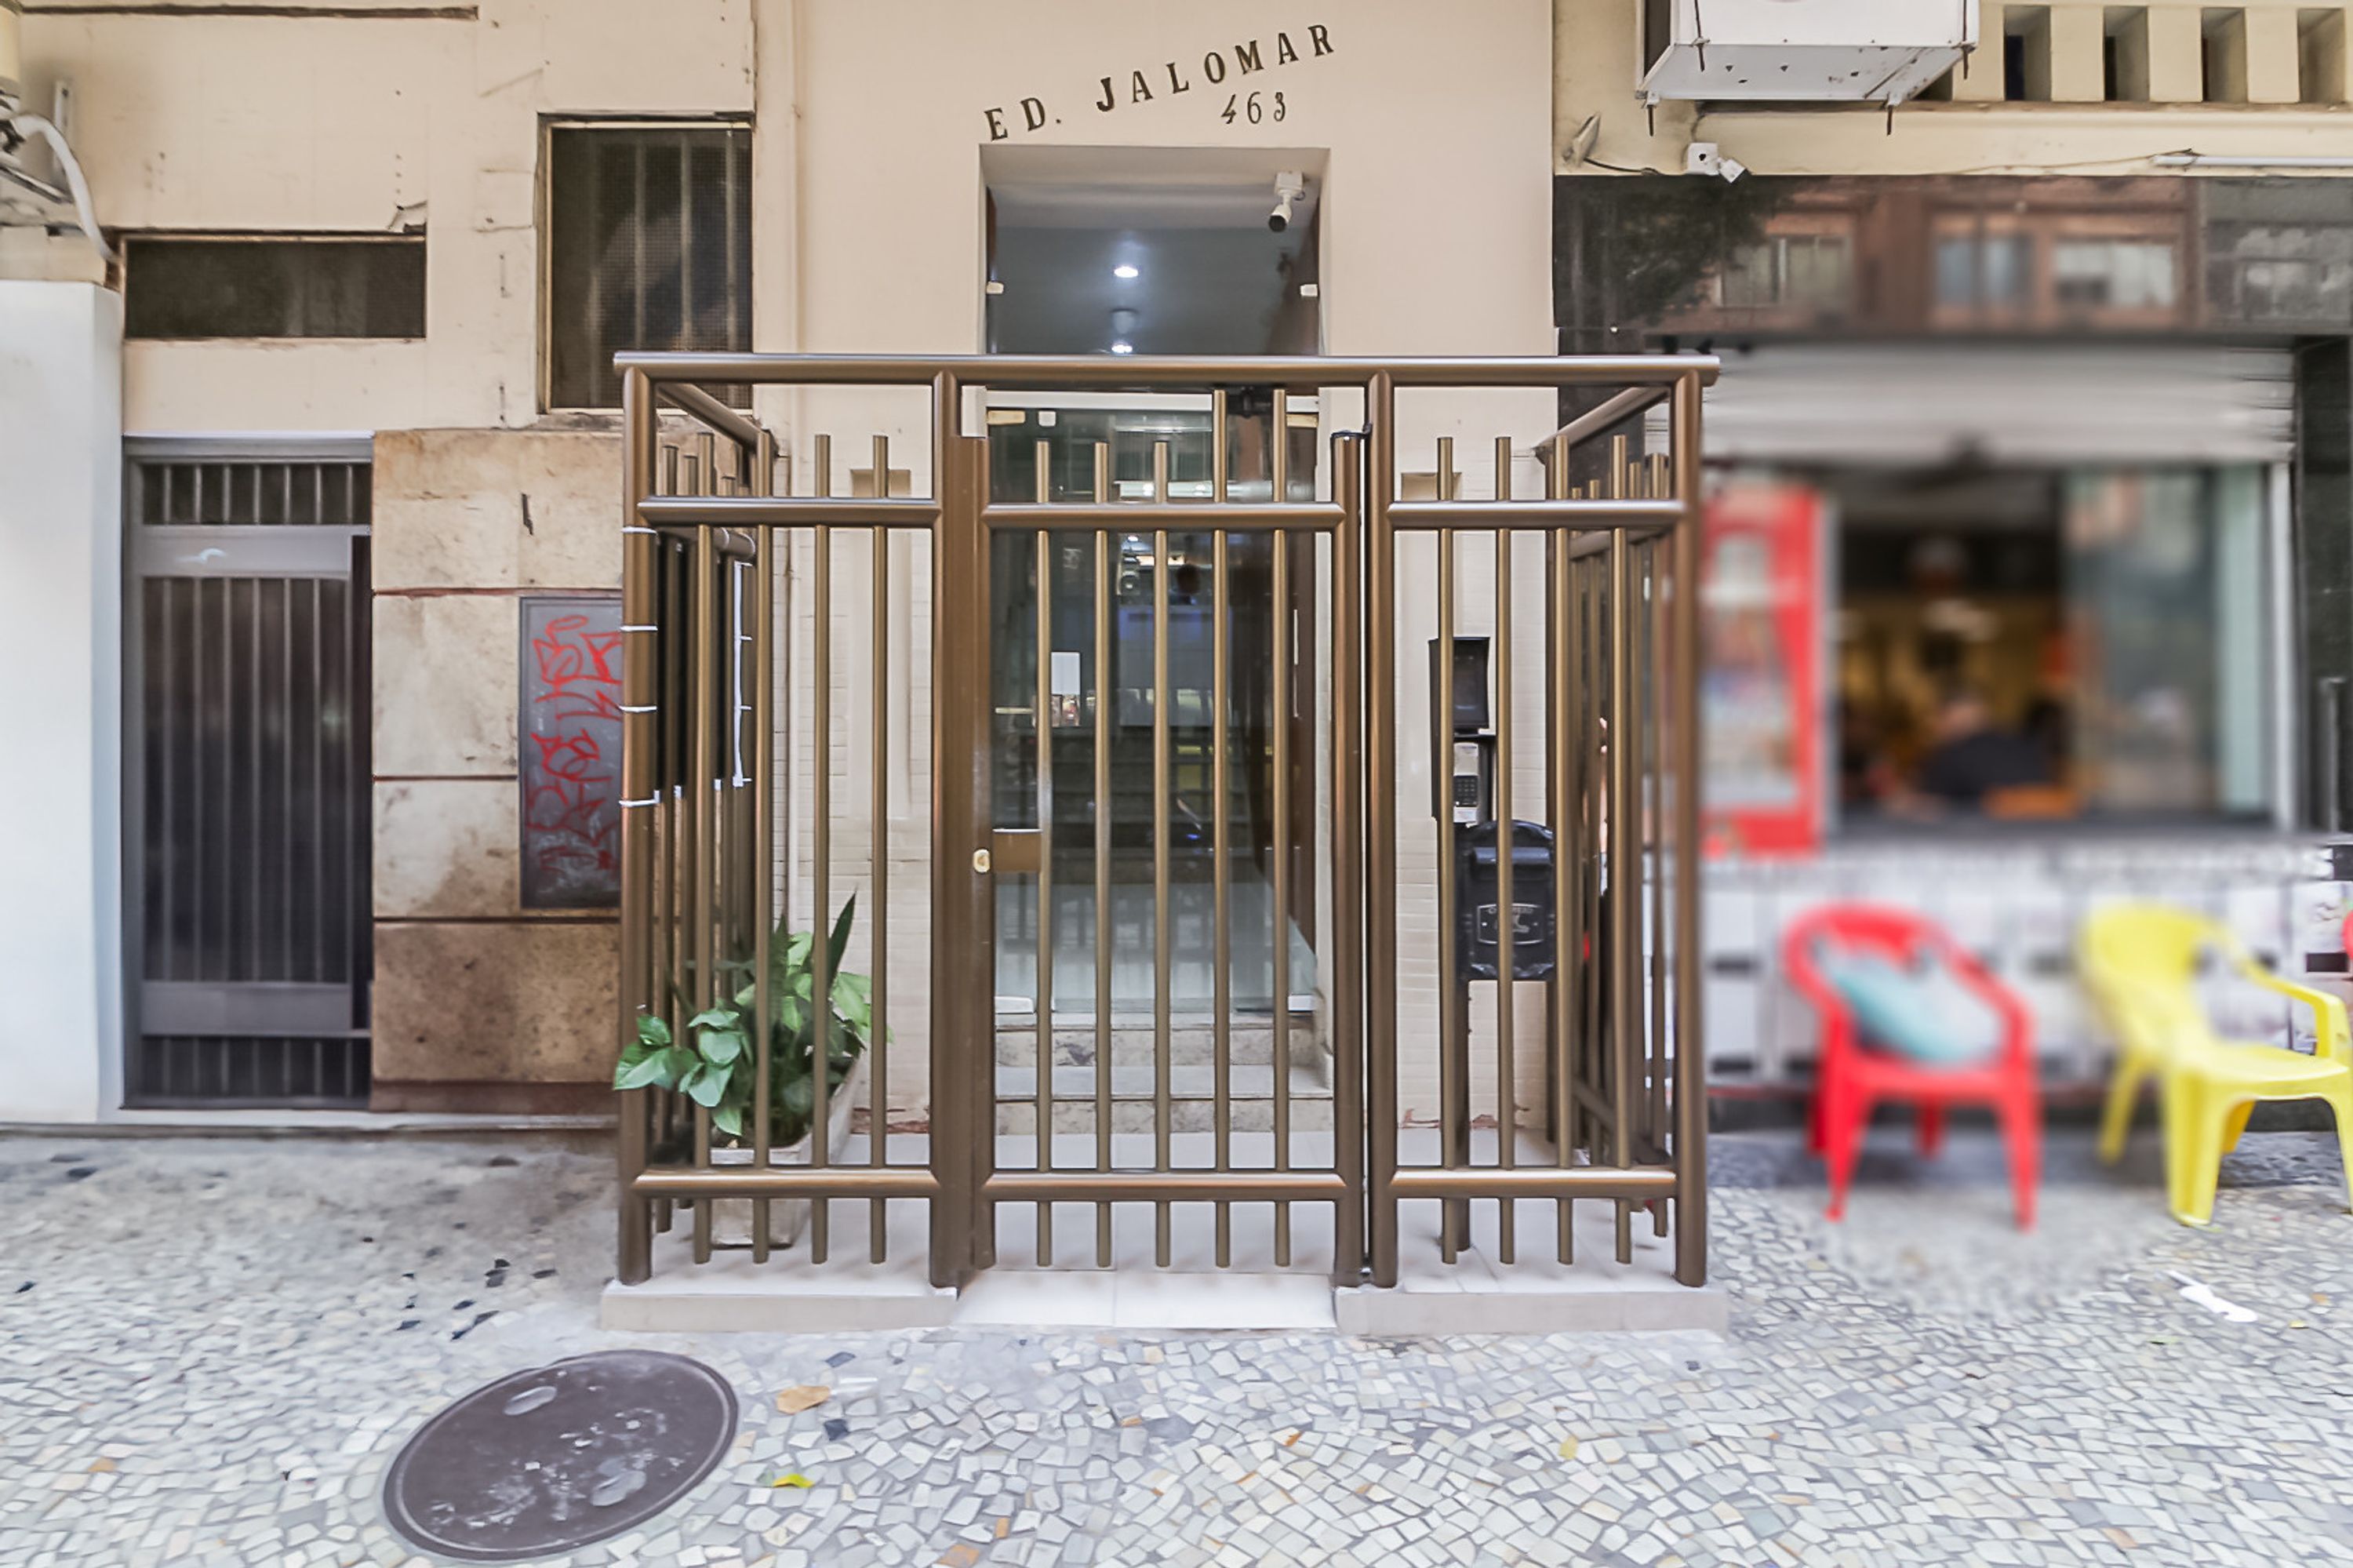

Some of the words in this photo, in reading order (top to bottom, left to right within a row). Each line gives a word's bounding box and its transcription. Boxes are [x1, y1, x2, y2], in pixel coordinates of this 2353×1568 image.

[983, 96, 1062, 142] ED.
[1096, 24, 1334, 113] JALOMAR
[1220, 91, 1286, 125] 463
